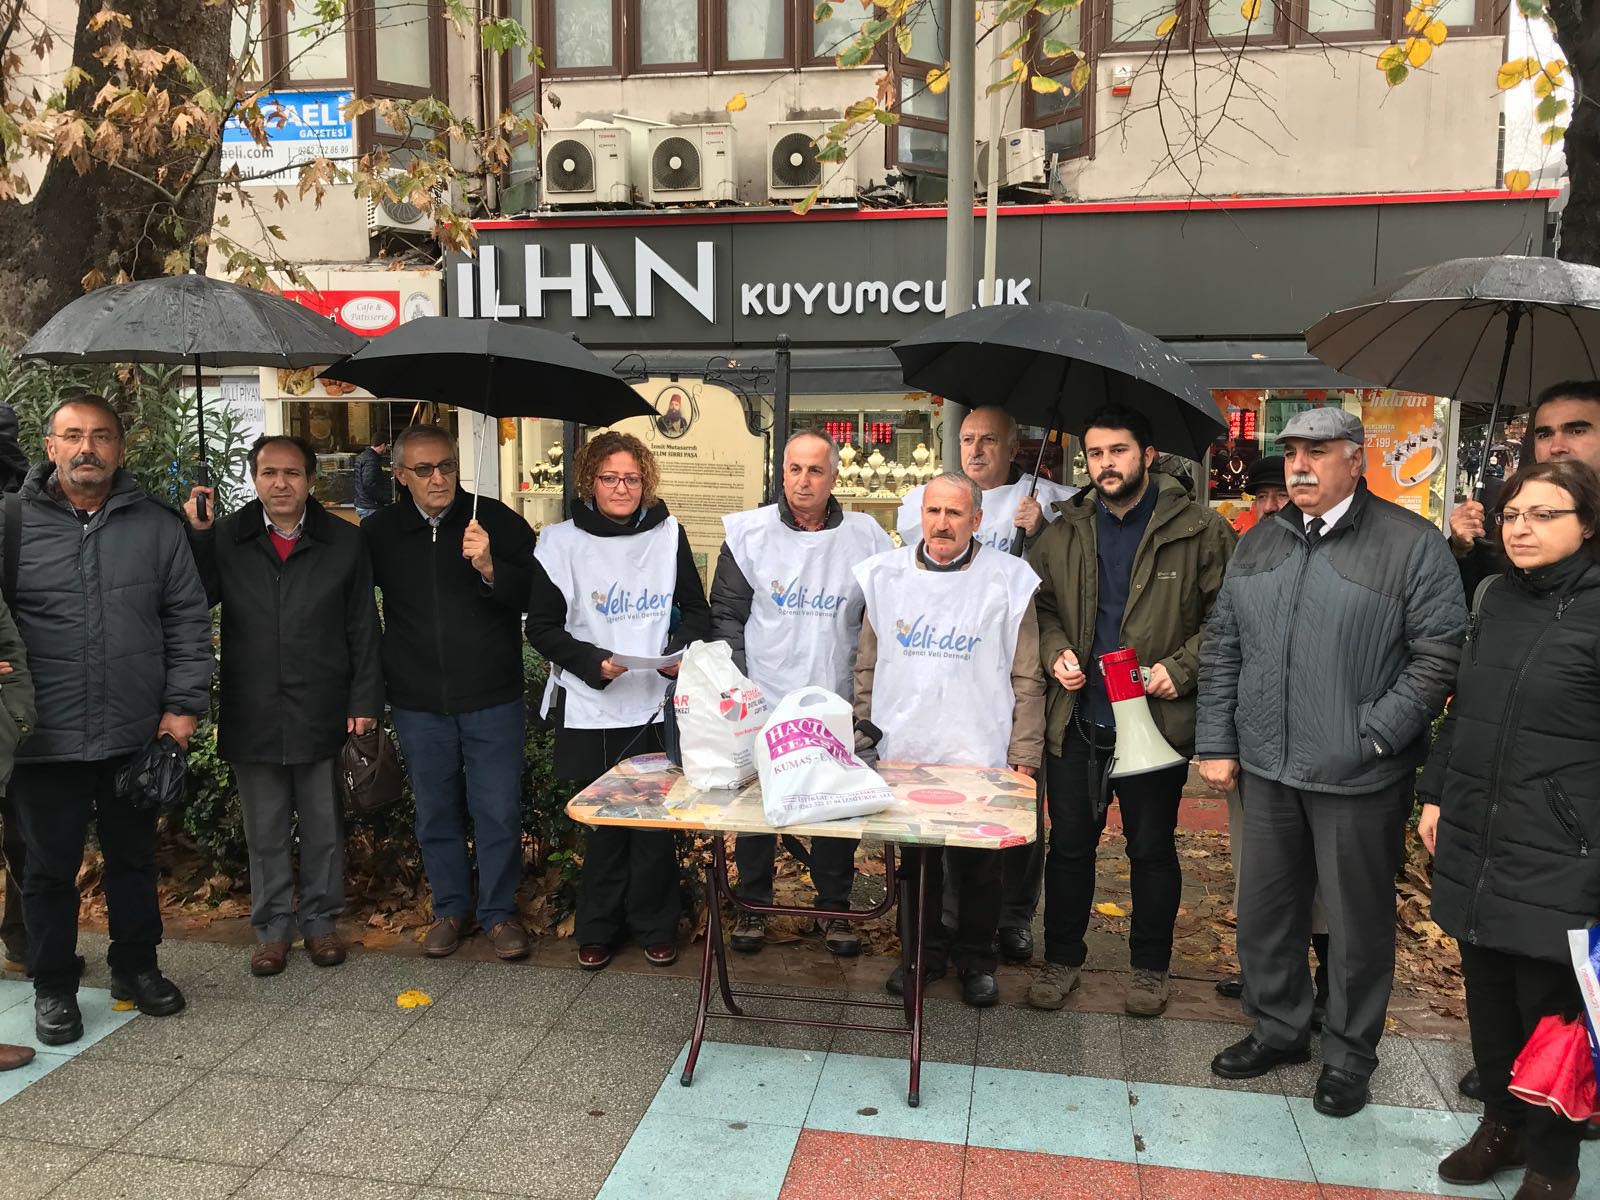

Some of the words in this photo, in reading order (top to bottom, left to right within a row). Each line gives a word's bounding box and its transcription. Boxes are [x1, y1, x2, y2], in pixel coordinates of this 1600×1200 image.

[299, 127, 347, 138] GAZETESİ
[330, 145, 339, 154] 86
[340, 145, 349, 154] 99
[741, 278, 1031, 316] KUYUMCUUK
[596, 581, 672, 616] Veli-der
[771, 576, 847, 610] Veli-der
[896, 614, 982, 652] Veli-der
[774, 754, 812, 775] KUMAŞ
